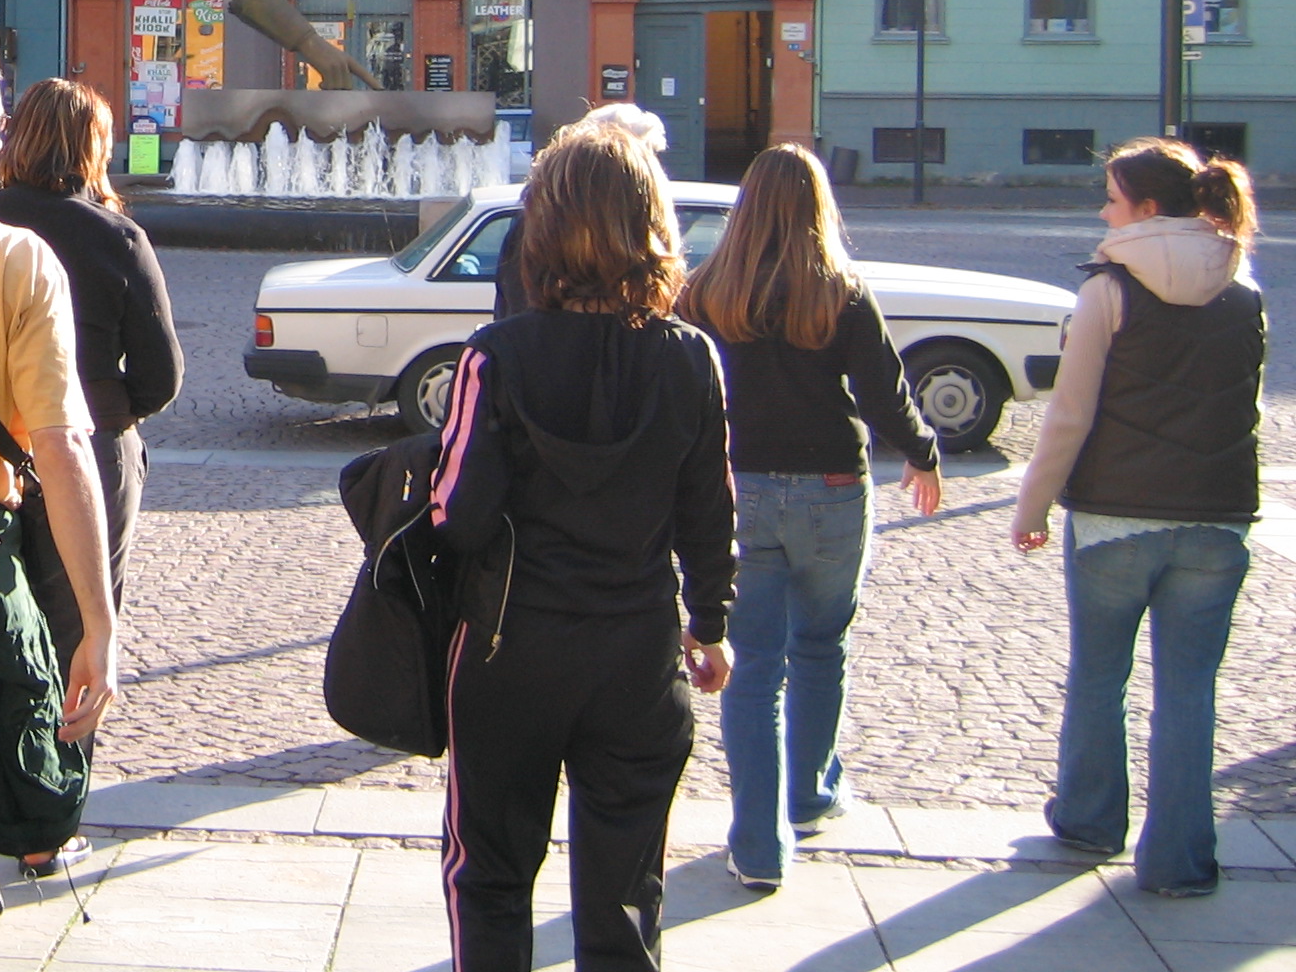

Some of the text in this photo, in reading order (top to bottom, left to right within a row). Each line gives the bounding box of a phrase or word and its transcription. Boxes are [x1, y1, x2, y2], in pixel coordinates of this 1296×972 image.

[475, 4, 525, 16] LEATHER
[135, 15, 175, 25] KHALIL
[195, 9, 224, 23] Kios
[135, 24, 171, 33] KIOSK
